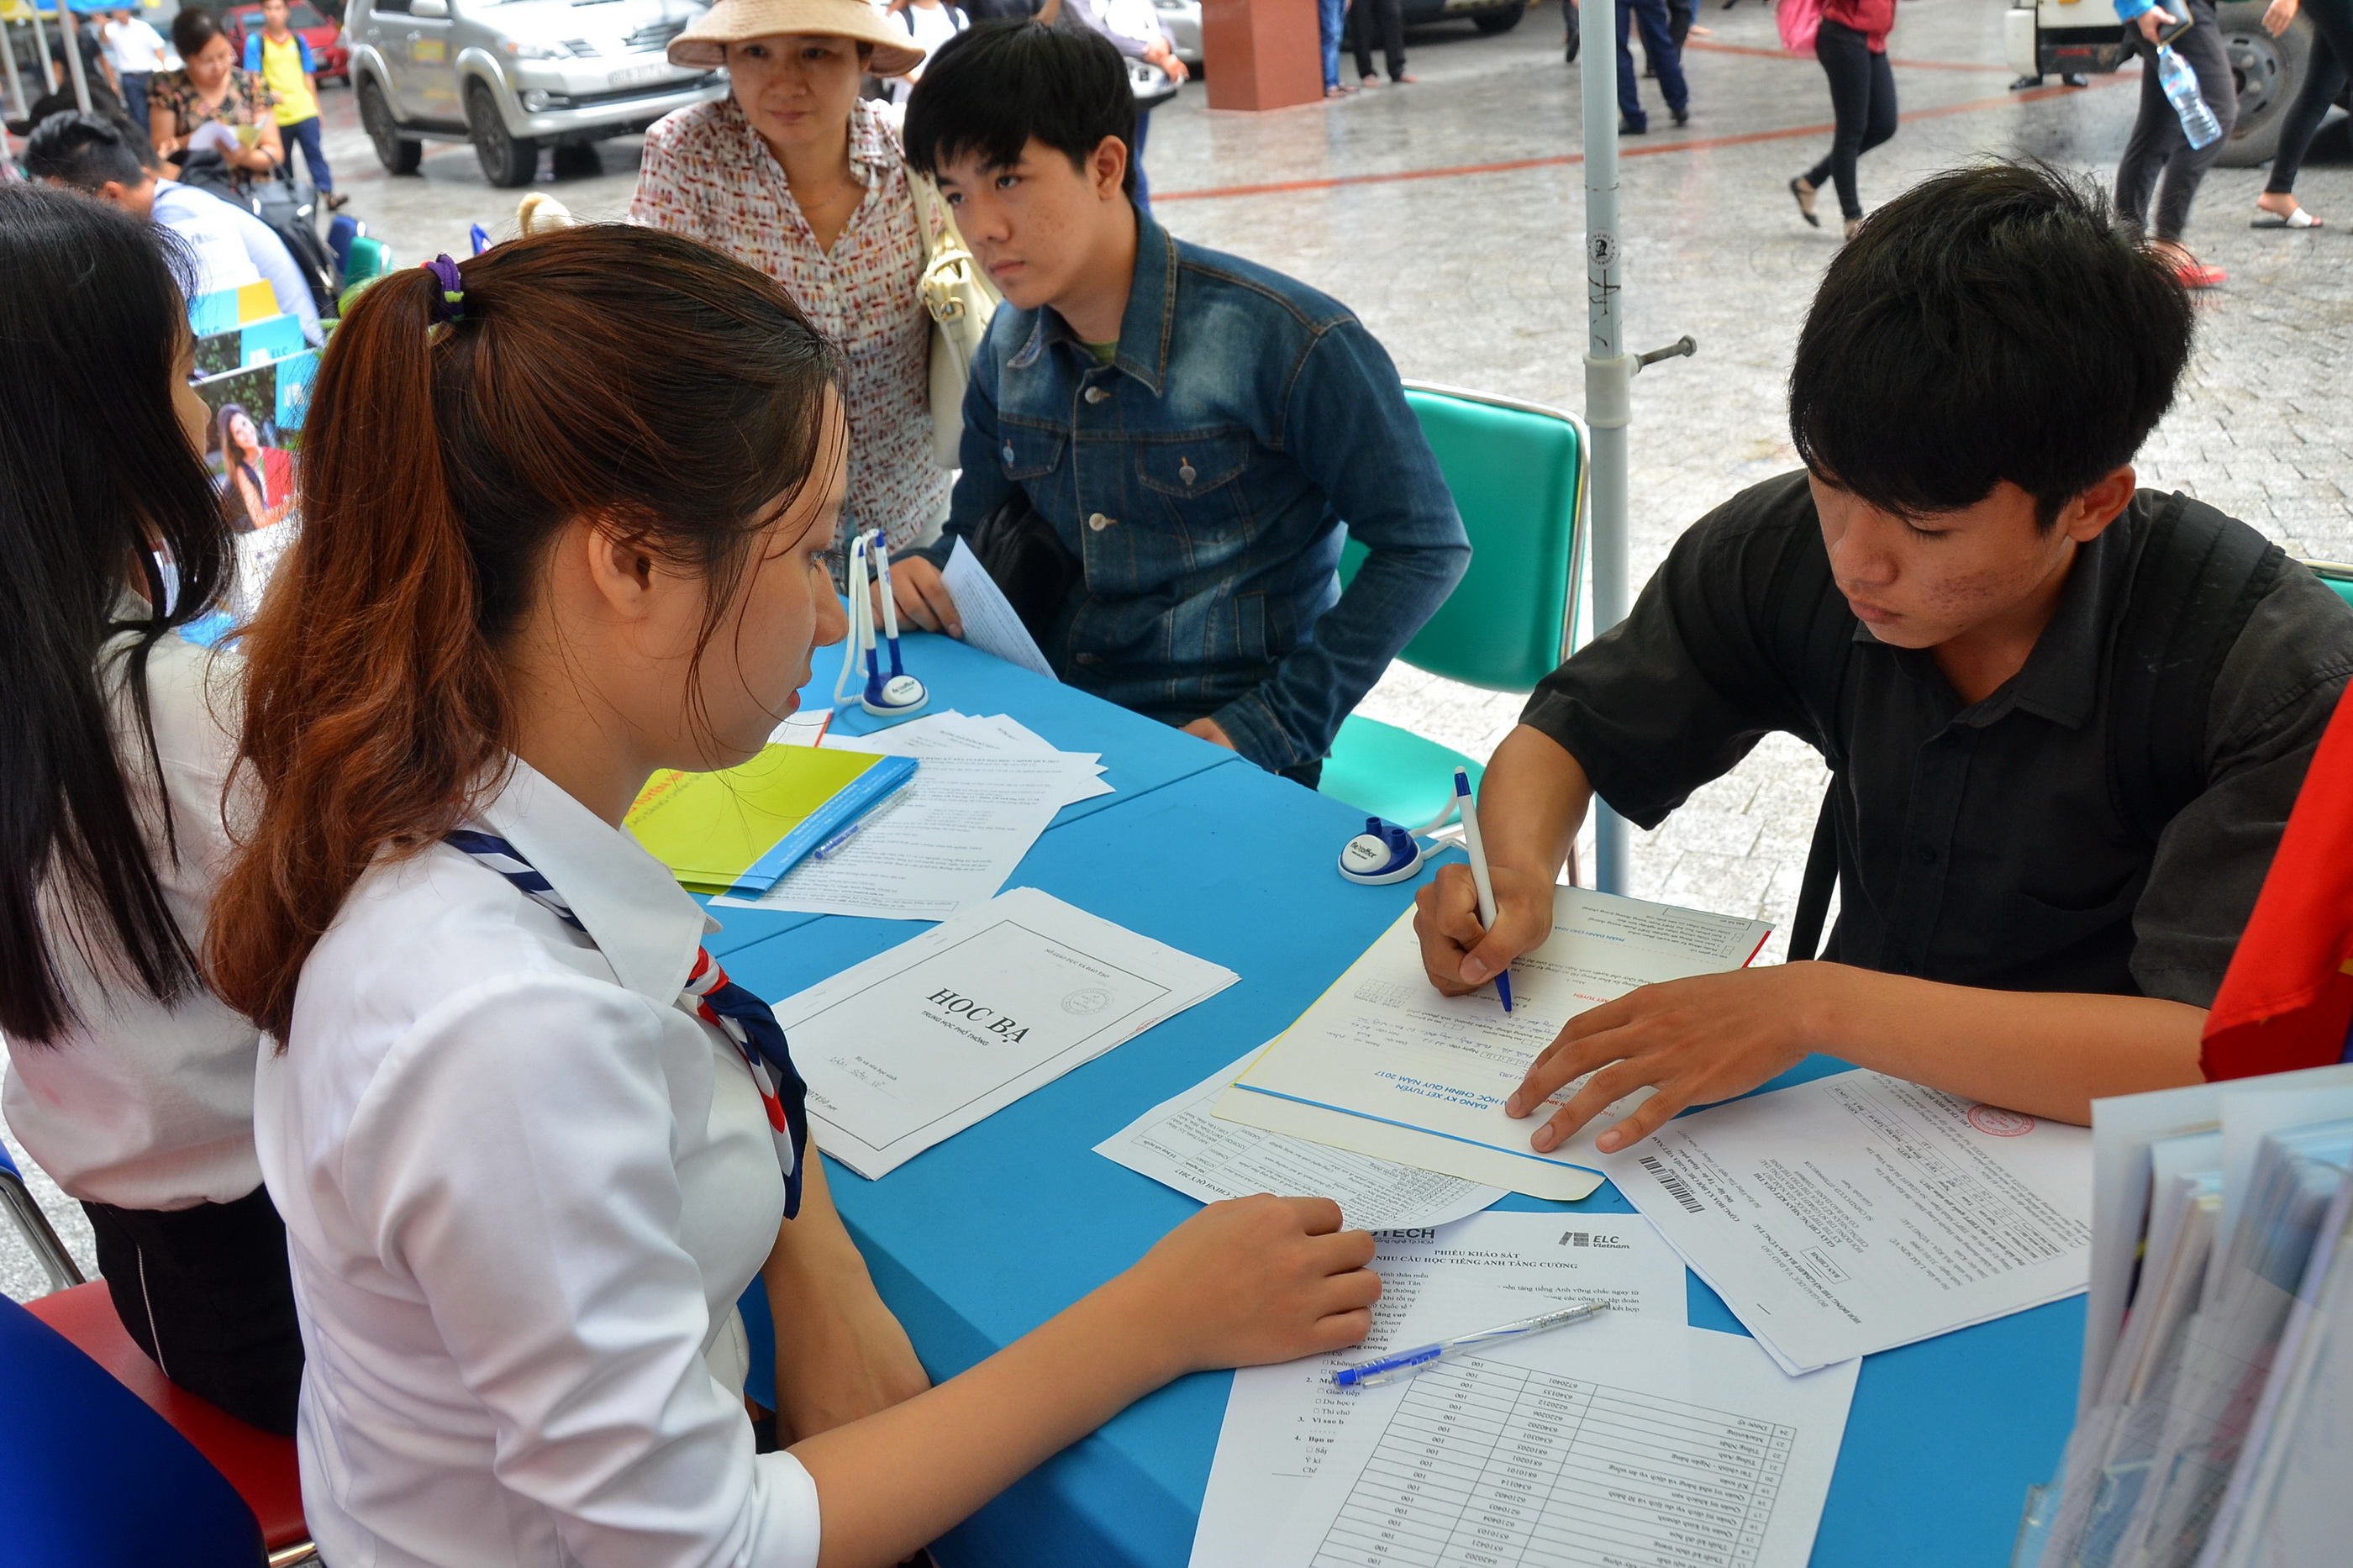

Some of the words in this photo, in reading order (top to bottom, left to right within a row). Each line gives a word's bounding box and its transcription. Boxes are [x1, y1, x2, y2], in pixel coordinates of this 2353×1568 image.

[271, 346, 288, 360] ELC
[926, 987, 995, 1023] HỌC
[986, 1016, 1031, 1044] BẠ
[921, 1010, 942, 1023] TRUNG
[940, 1018, 955, 1030] HỌC
[966, 1030, 990, 1046] THÔNG
[1461, 1046, 1479, 1055] Ngày
[885, 1073, 898, 1081] sinh
[1374, 1071, 1397, 1080] 2017
[1397, 1076, 1422, 1087] NĂM
[1421, 1081, 1444, 1091] QUY
[1395, 1083, 1424, 1095] TUYỂN
[1444, 1087, 1475, 1098] CHÍNH
[1425, 1091, 1443, 1099] XÉT
[1477, 1094, 1499, 1104] HỌC
[1459, 1098, 1489, 1110] ĐĂNG
[1651, 1136, 1663, 1148] NAM
[1174, 1169, 1192, 1180] 2017
[1191, 1176, 1207, 1185] QUY
[1205, 1181, 1231, 1197] CHÍNH
[1723, 1208, 1740, 1223] CỘNG
[1592, 1235, 1619, 1244] ELC
[1449, 1257, 1481, 1265] TIẾNG
[1810, 1251, 1829, 1268] CHÍNH
[1826, 1265, 1841, 1279] BẢN
[1534, 1285, 1553, 1293] tiếng
[1549, 1377, 1578, 1389] 6720401
[1345, 1389, 1361, 1397] tiếp
[1543, 1389, 1573, 1400] 6340135
[1538, 1399, 1568, 1410] 6220212
[1533, 1410, 1564, 1422] 6220206
[1437, 1425, 1450, 1434] 100
[1527, 1422, 1558, 1433] 6340202
[1431, 1436, 1445, 1444] 100
[1523, 1433, 1553, 1444] 6340301
[1726, 1429, 1764, 1444] Marketing
[1517, 1444, 1548, 1455] 6810205
[1512, 1455, 1543, 1466] 6810201
[1507, 1466, 1538, 1478] 6810101
[1501, 1479, 1532, 1491] 6340114
[1494, 1491, 1526, 1502] 6210402
[1488, 1503, 1520, 1515] 6210403
[1482, 1515, 1515, 1527] 6210404
[1477, 1528, 1509, 1539] 6510103
[1471, 1539, 1503, 1552] 6510421
